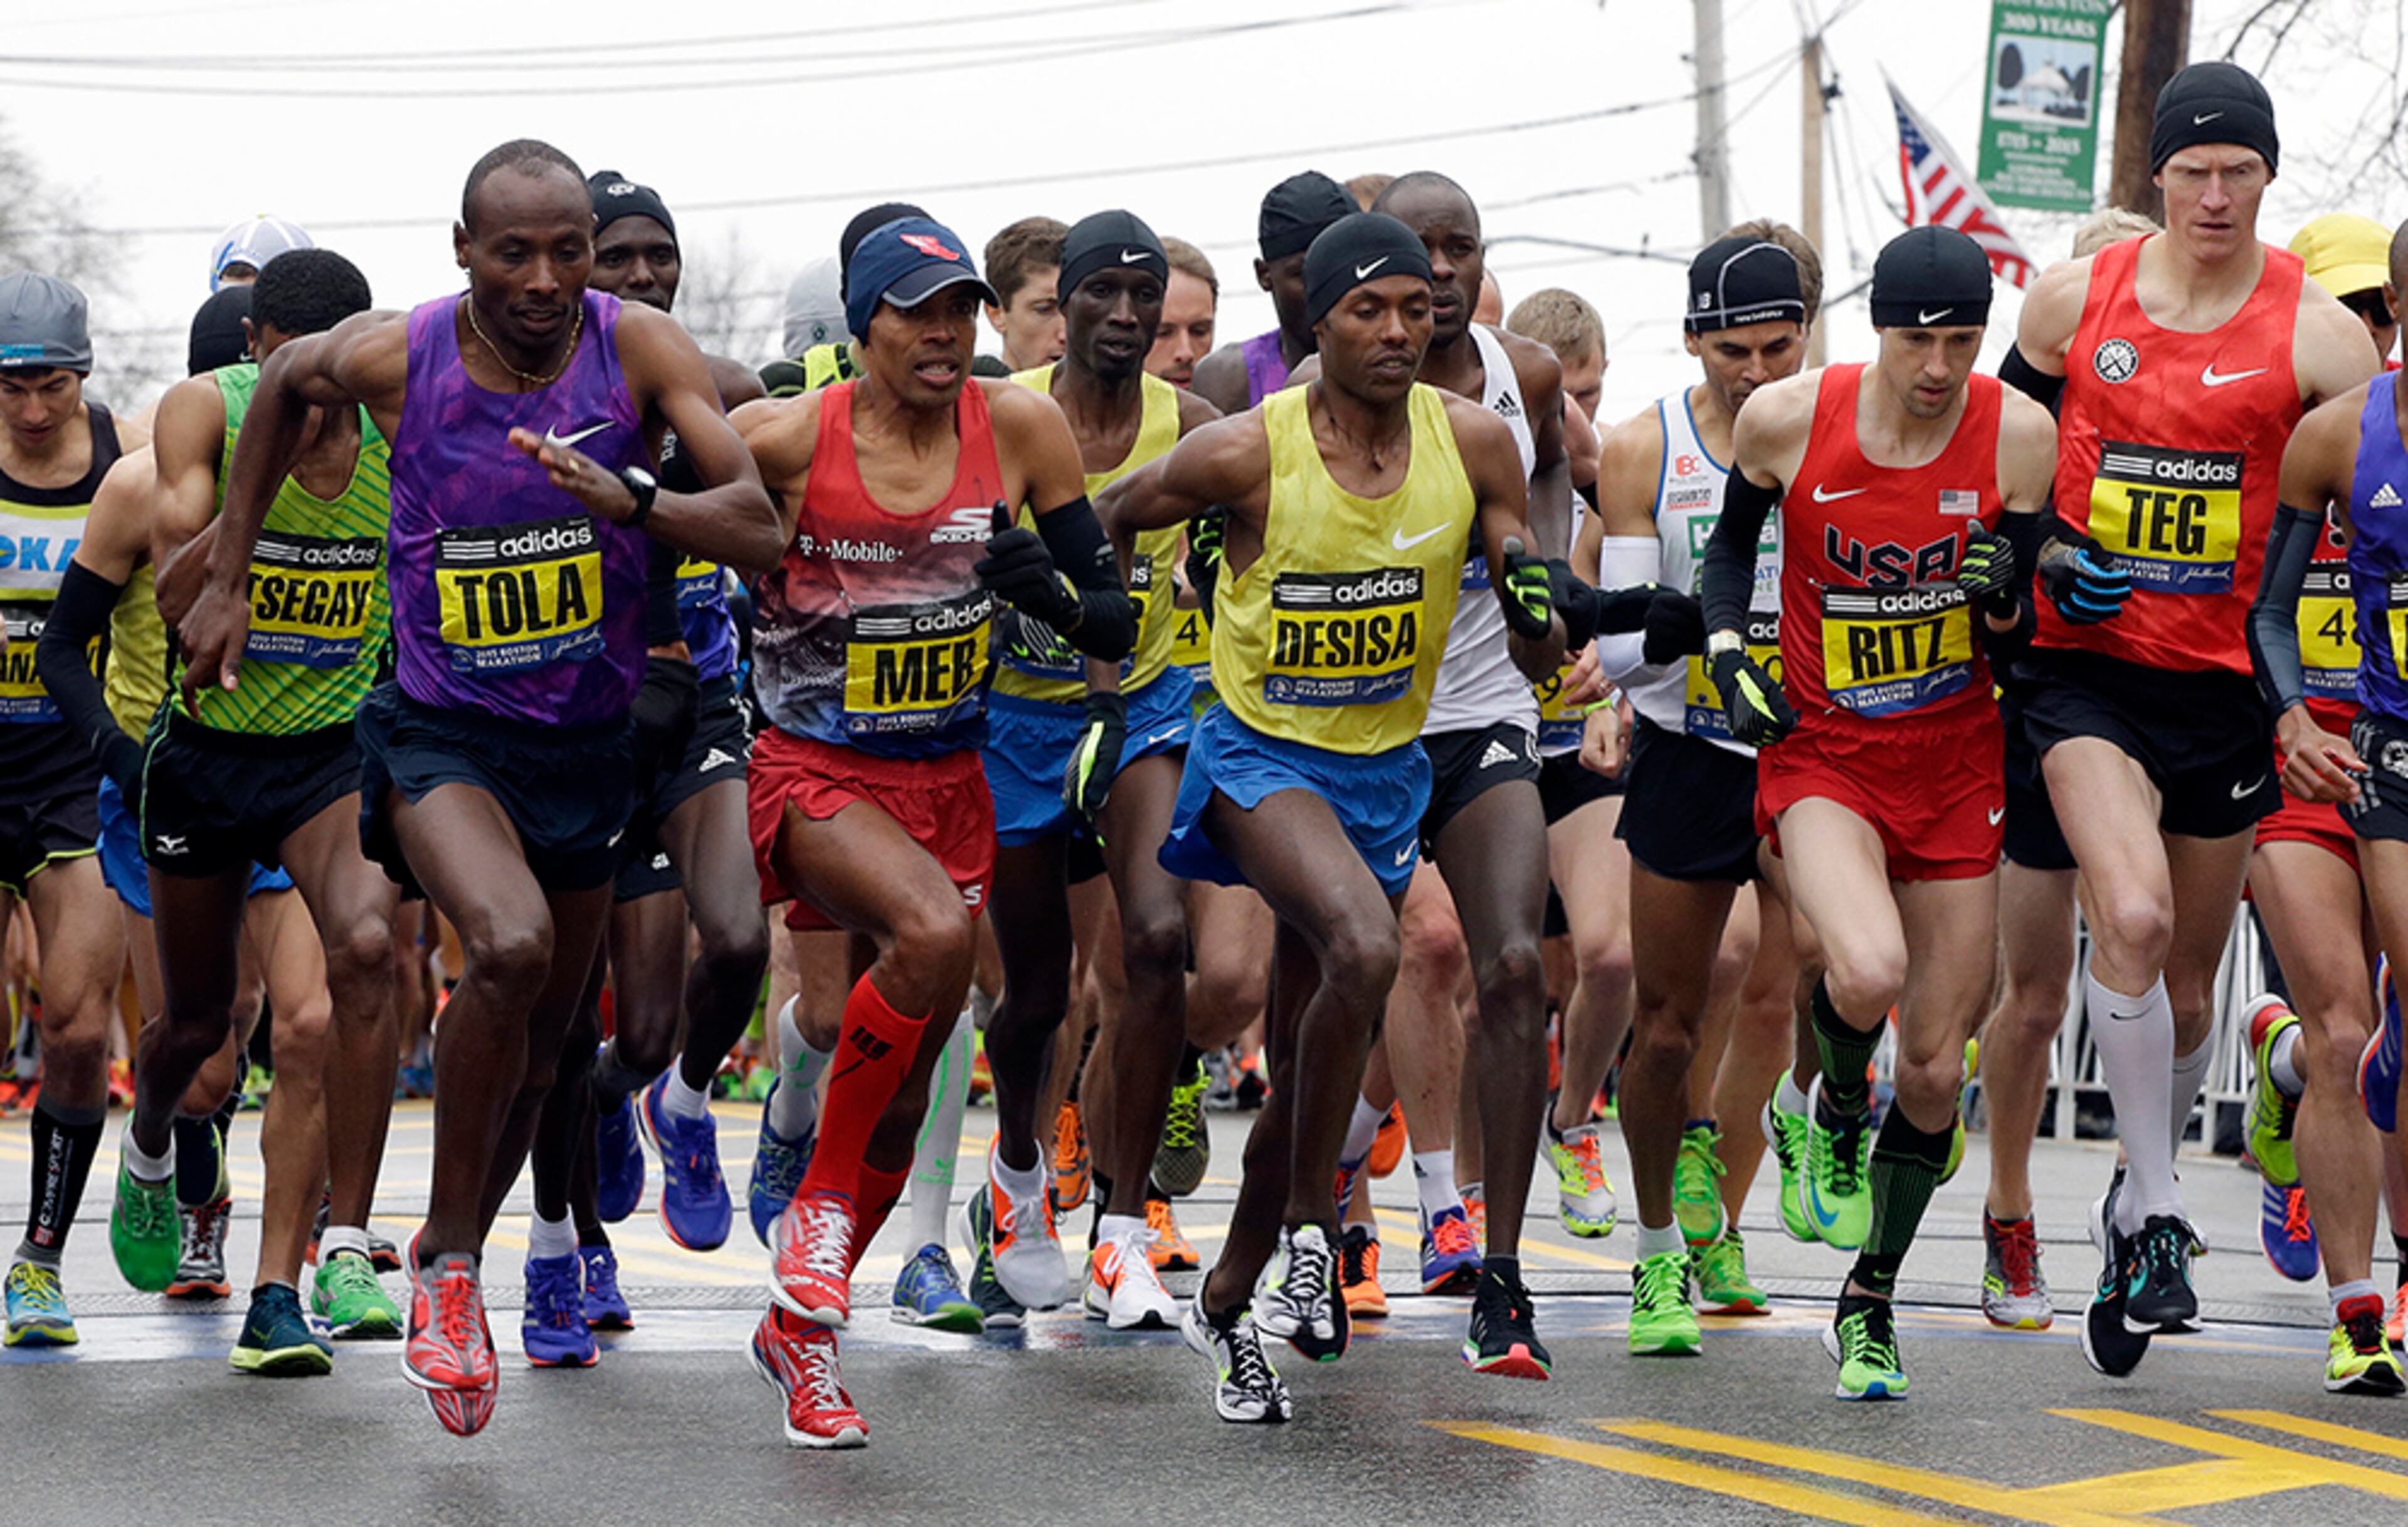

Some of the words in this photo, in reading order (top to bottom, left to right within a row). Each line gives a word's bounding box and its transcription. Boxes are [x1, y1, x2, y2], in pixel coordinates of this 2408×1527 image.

[2039, 15, 2098, 39] YEARS
[2155, 458, 2237, 482] adidas
[2126, 488, 2207, 555] TEG
[500, 527, 592, 556] adidas
[930, 532, 993, 543] SKECHE
[303, 544, 378, 564] adidas
[1825, 523, 1958, 588] USA
[455, 563, 588, 638] TOLA
[1335, 577, 1418, 603] adidas
[1881, 589, 1966, 613] adidas
[1274, 611, 1416, 667] DESISA
[1848, 617, 1948, 682] RITZ
[874, 638, 976, 706] MEB
[2305, 679, 2356, 687] MARATHO
